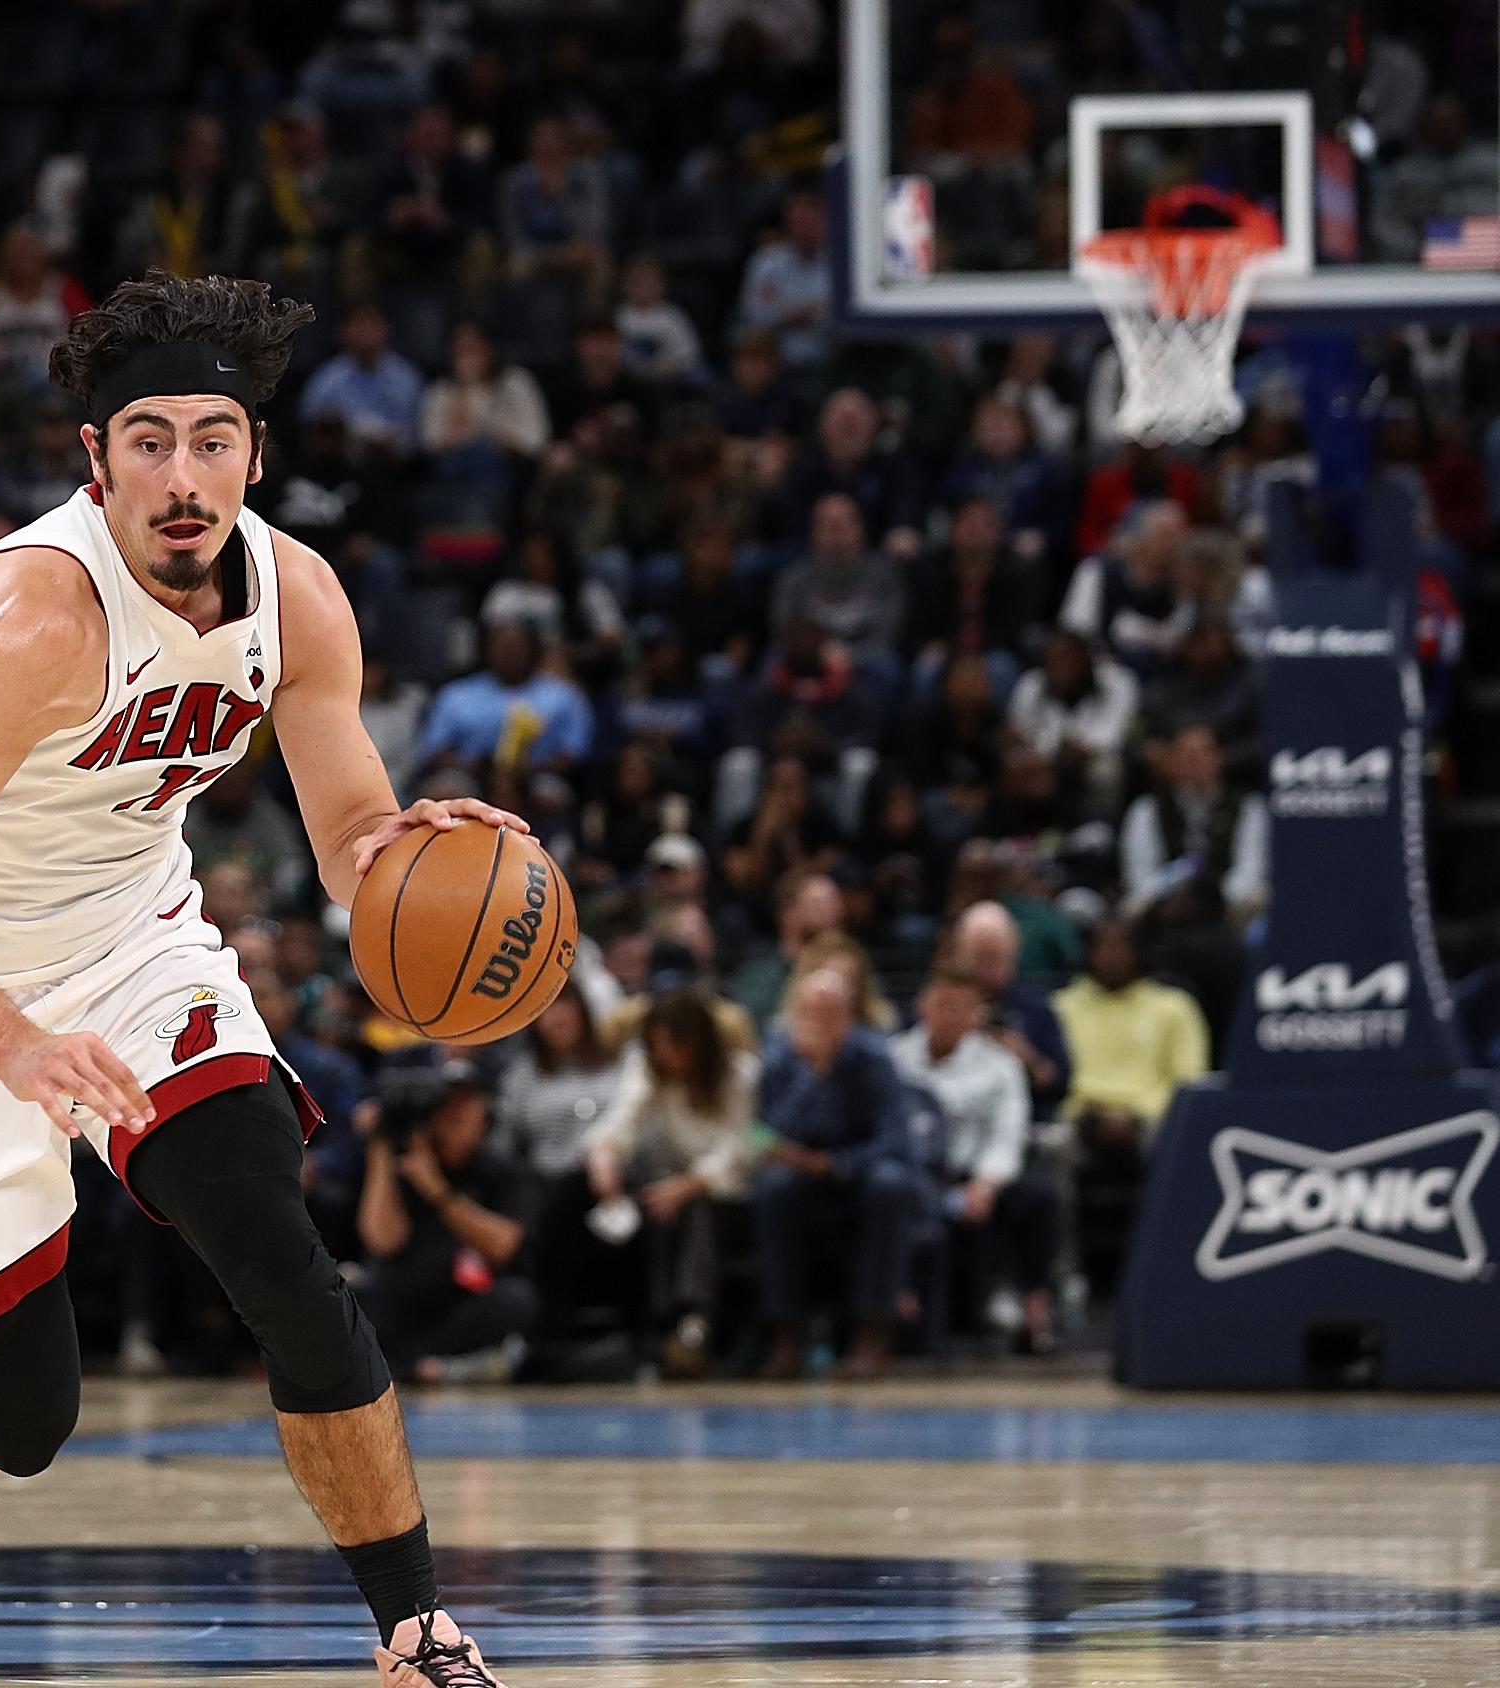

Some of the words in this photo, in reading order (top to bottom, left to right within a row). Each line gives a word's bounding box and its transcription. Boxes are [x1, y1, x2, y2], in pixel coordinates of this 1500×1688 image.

[67, 682, 265, 772] HEAT
[469, 861, 547, 1000] Wilson
[1238, 1167, 1458, 1234] SONIC
